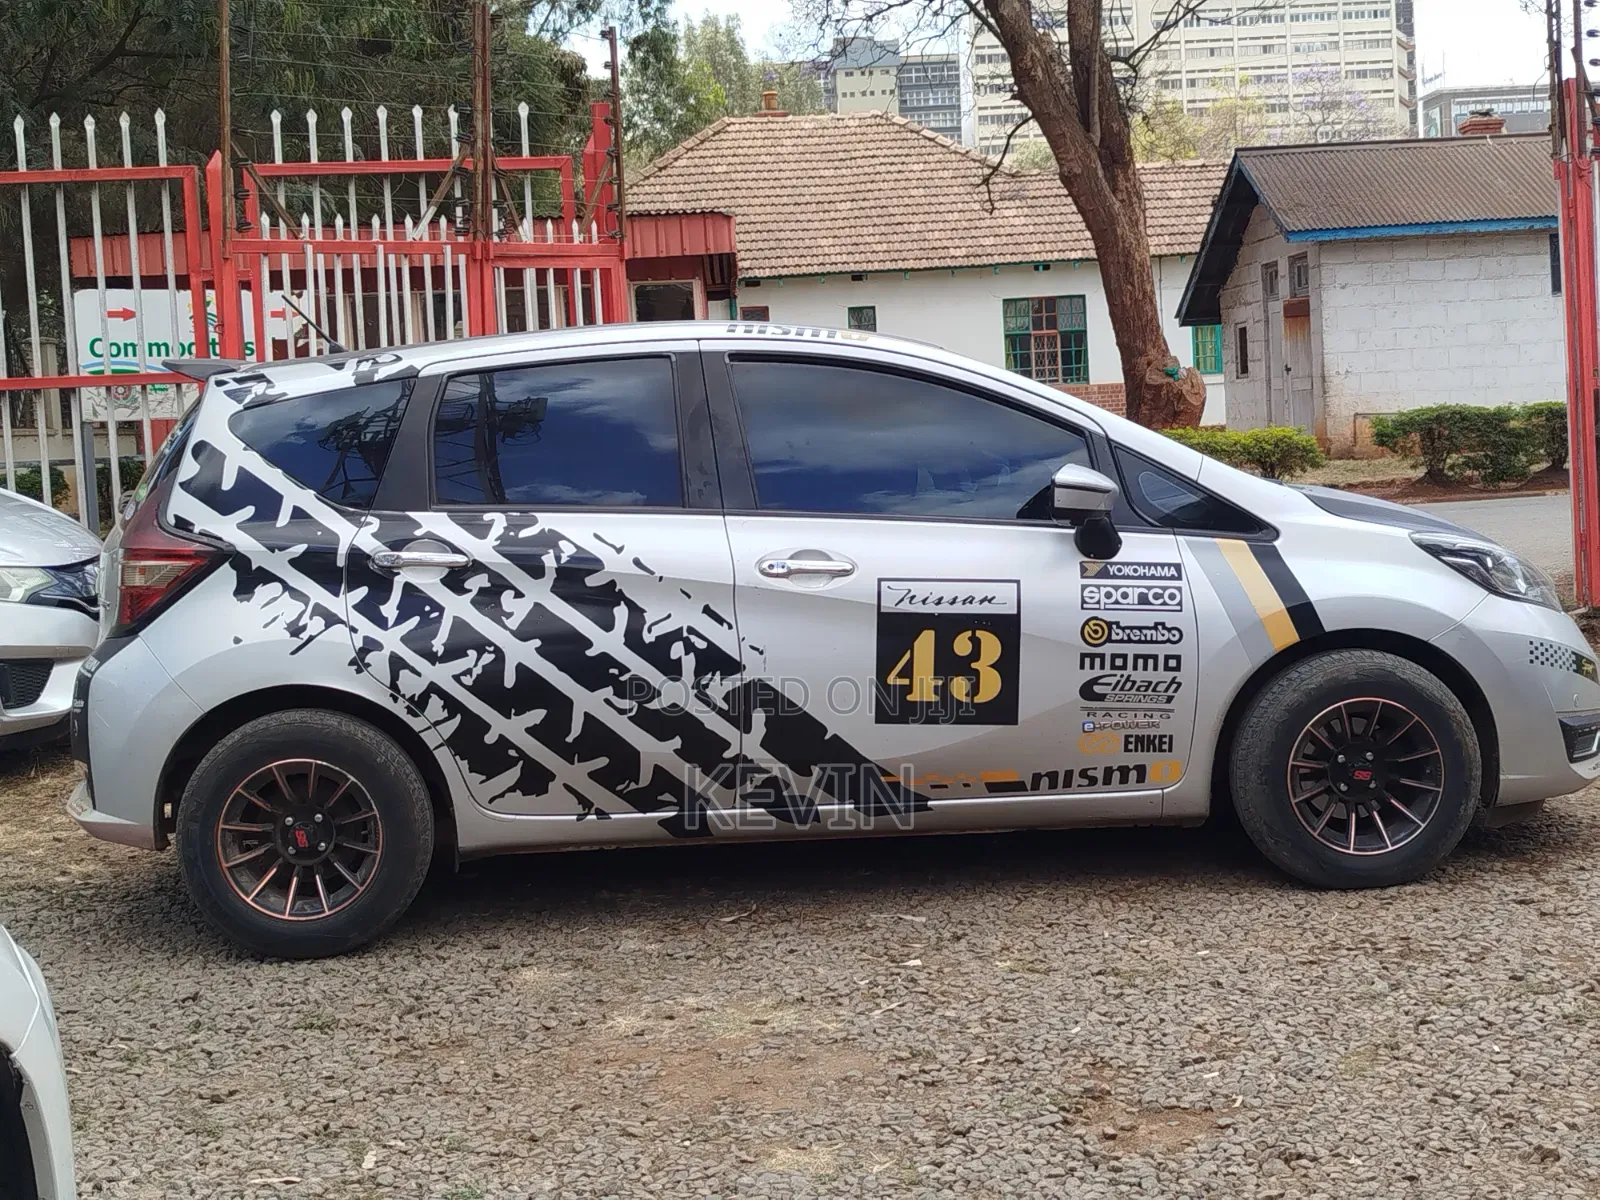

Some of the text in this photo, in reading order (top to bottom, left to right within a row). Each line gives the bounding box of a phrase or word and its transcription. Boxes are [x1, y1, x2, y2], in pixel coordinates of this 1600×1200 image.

[88, 337, 255, 358] Commots
[1107, 565, 1178, 577] YOKOHAMA
[887, 585, 1007, 607] Nissan
[1083, 586, 1181, 609] sparco
[1111, 624, 1180, 641] brembo
[887, 629, 1002, 704] 43
[1079, 673, 1183, 700] Eibach
[1104, 694, 1168, 704] SPRINGS
[1086, 711, 1172, 720] RACING
[1123, 734, 1174, 753] ENKEI
